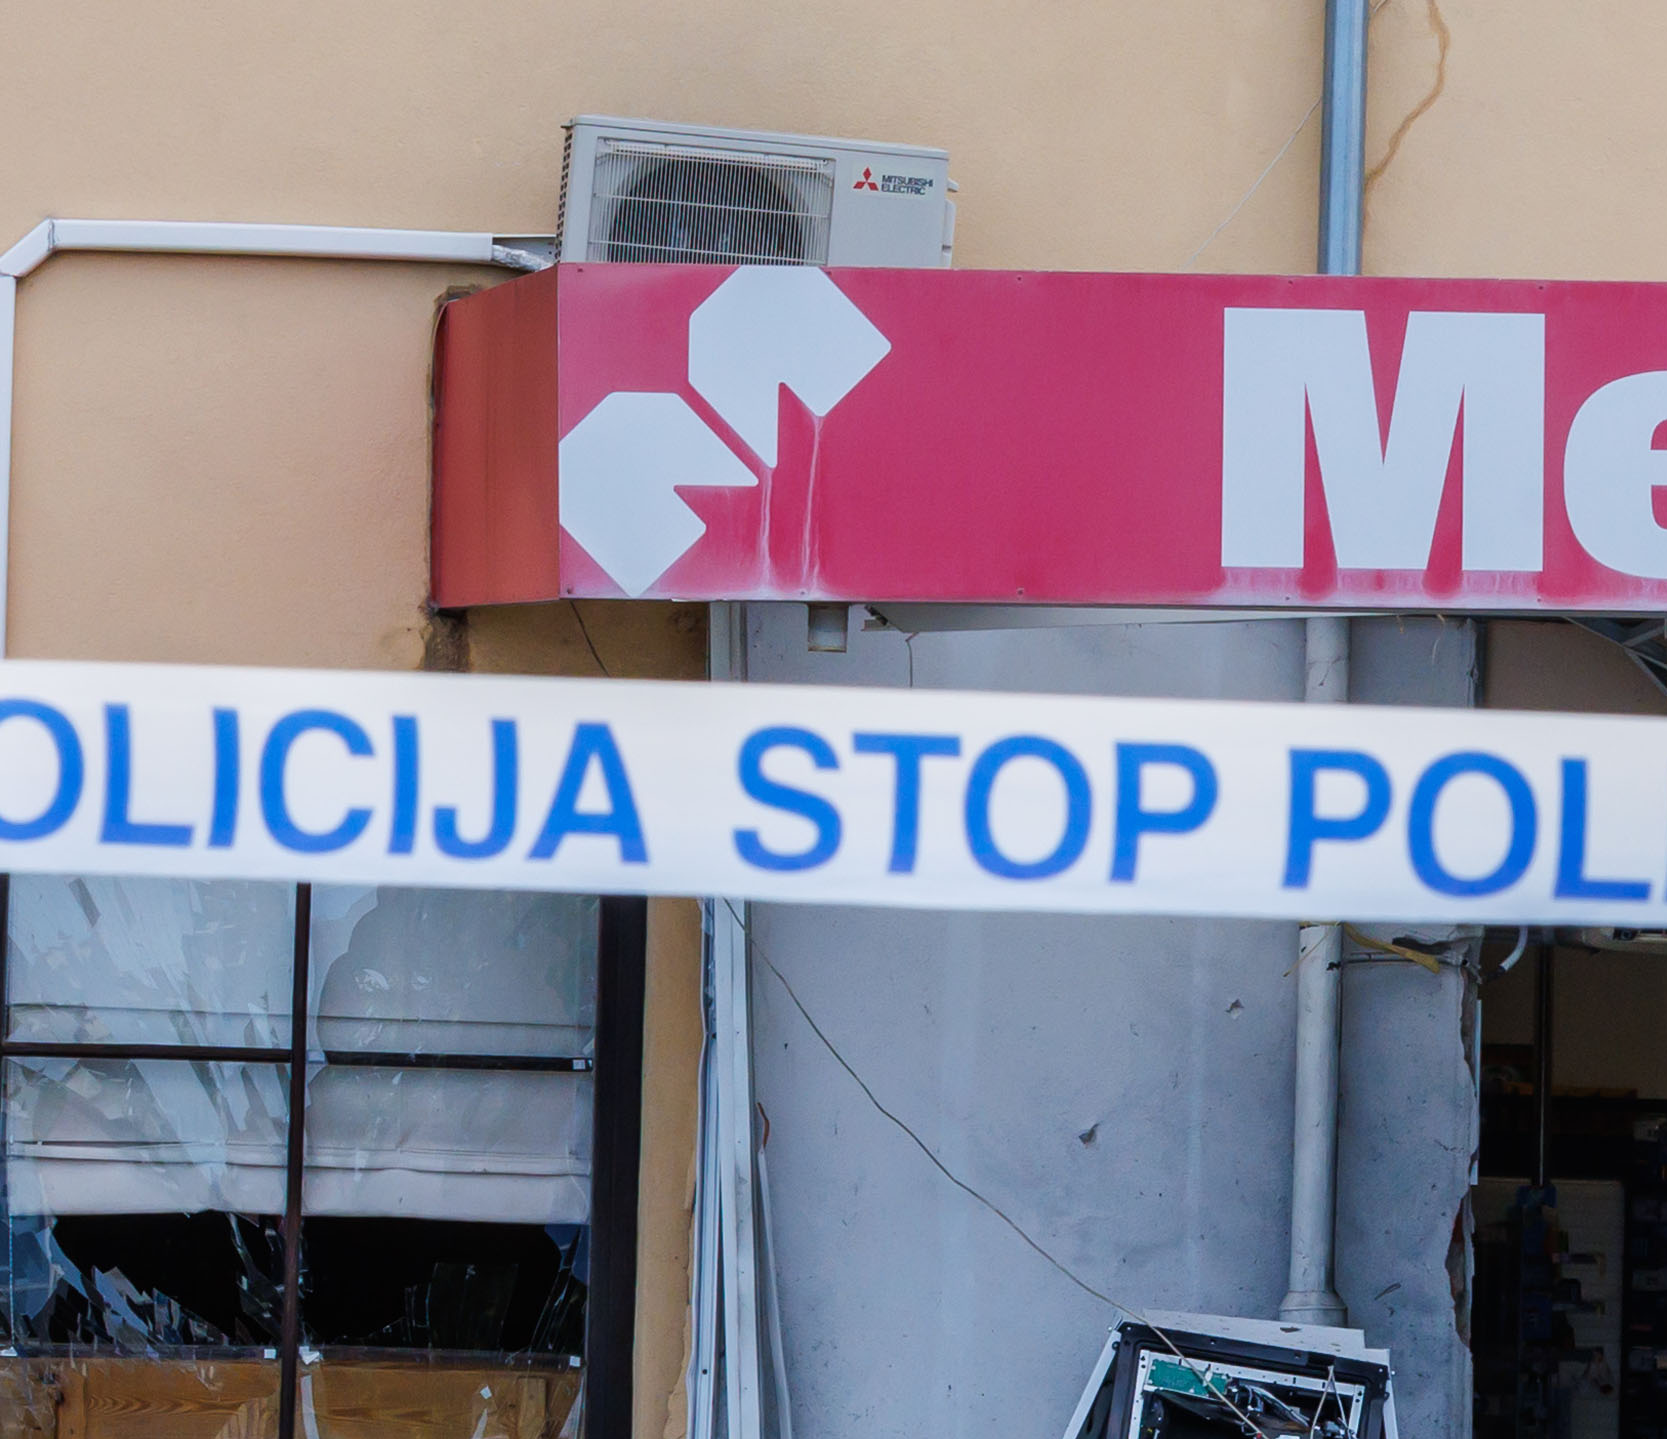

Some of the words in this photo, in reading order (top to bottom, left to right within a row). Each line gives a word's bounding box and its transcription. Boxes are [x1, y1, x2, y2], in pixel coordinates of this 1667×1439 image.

[881, 174, 934, 187] MITSUBISHI
[881, 183, 926, 195] ELECTRIC
[733, 725, 1219, 884] STOP
